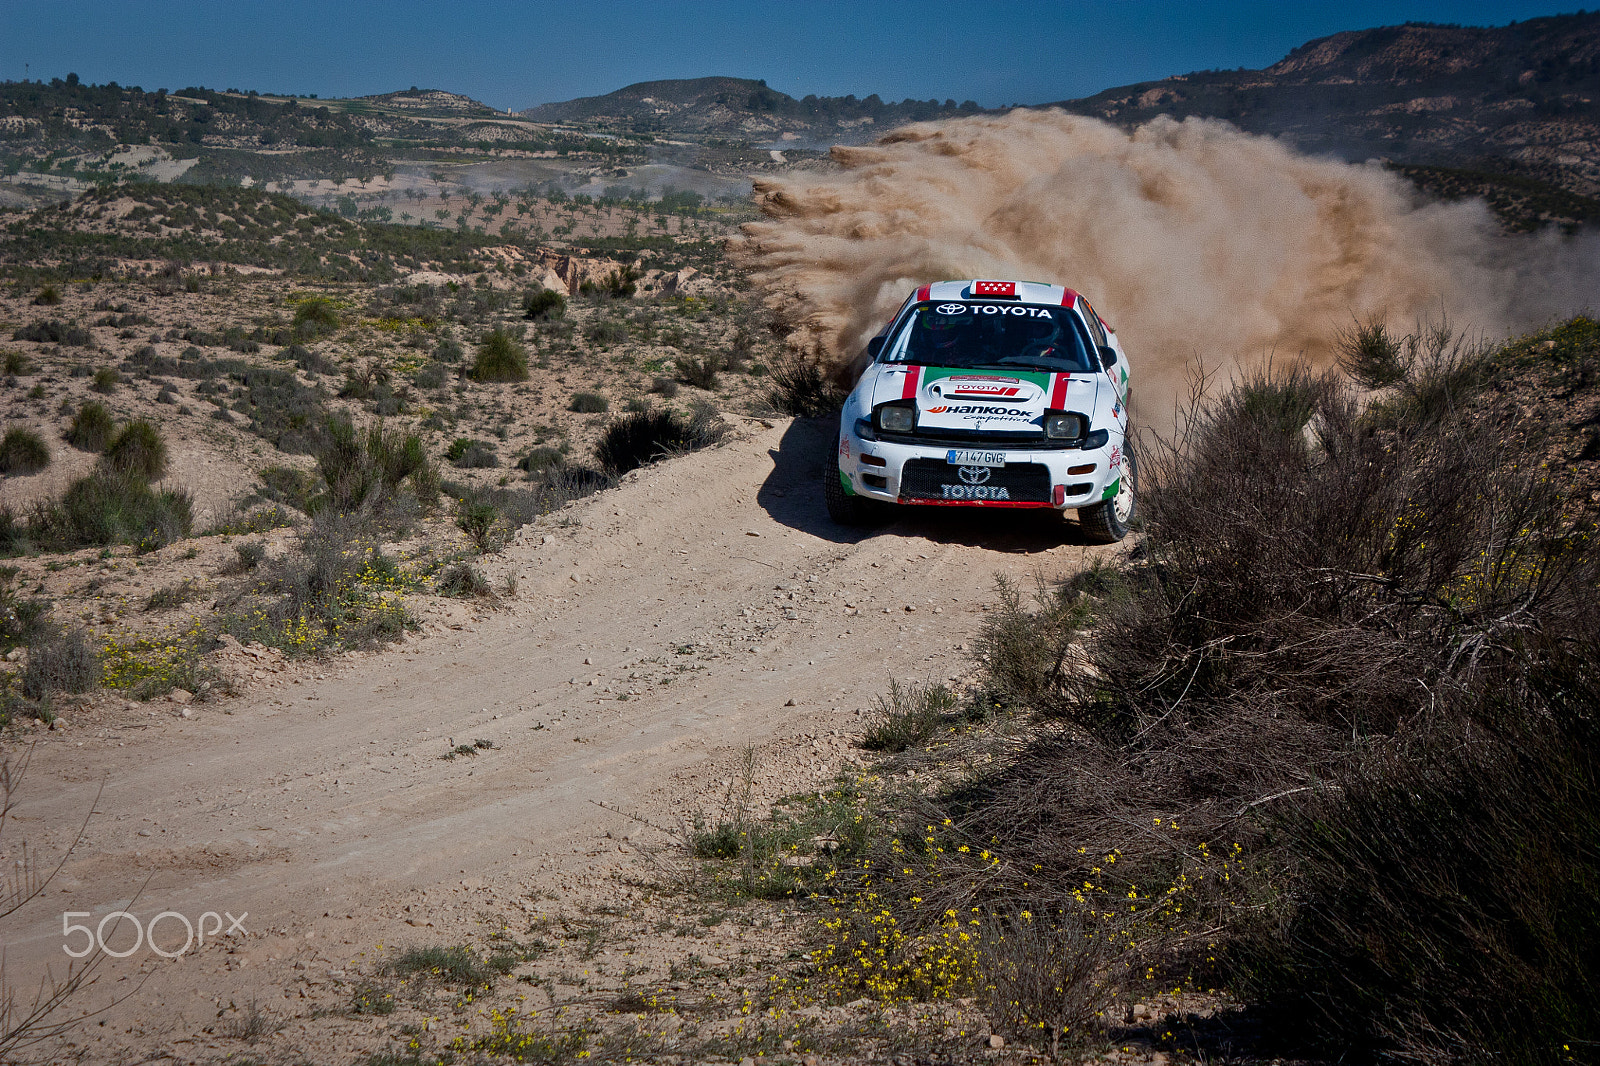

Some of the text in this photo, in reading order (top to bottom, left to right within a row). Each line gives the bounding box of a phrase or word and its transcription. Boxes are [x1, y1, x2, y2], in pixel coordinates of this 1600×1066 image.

[970, 305, 1052, 319] TOYOTA
[957, 452, 1003, 463] 7147 GVG
[941, 484, 1010, 499] TOYOTA
